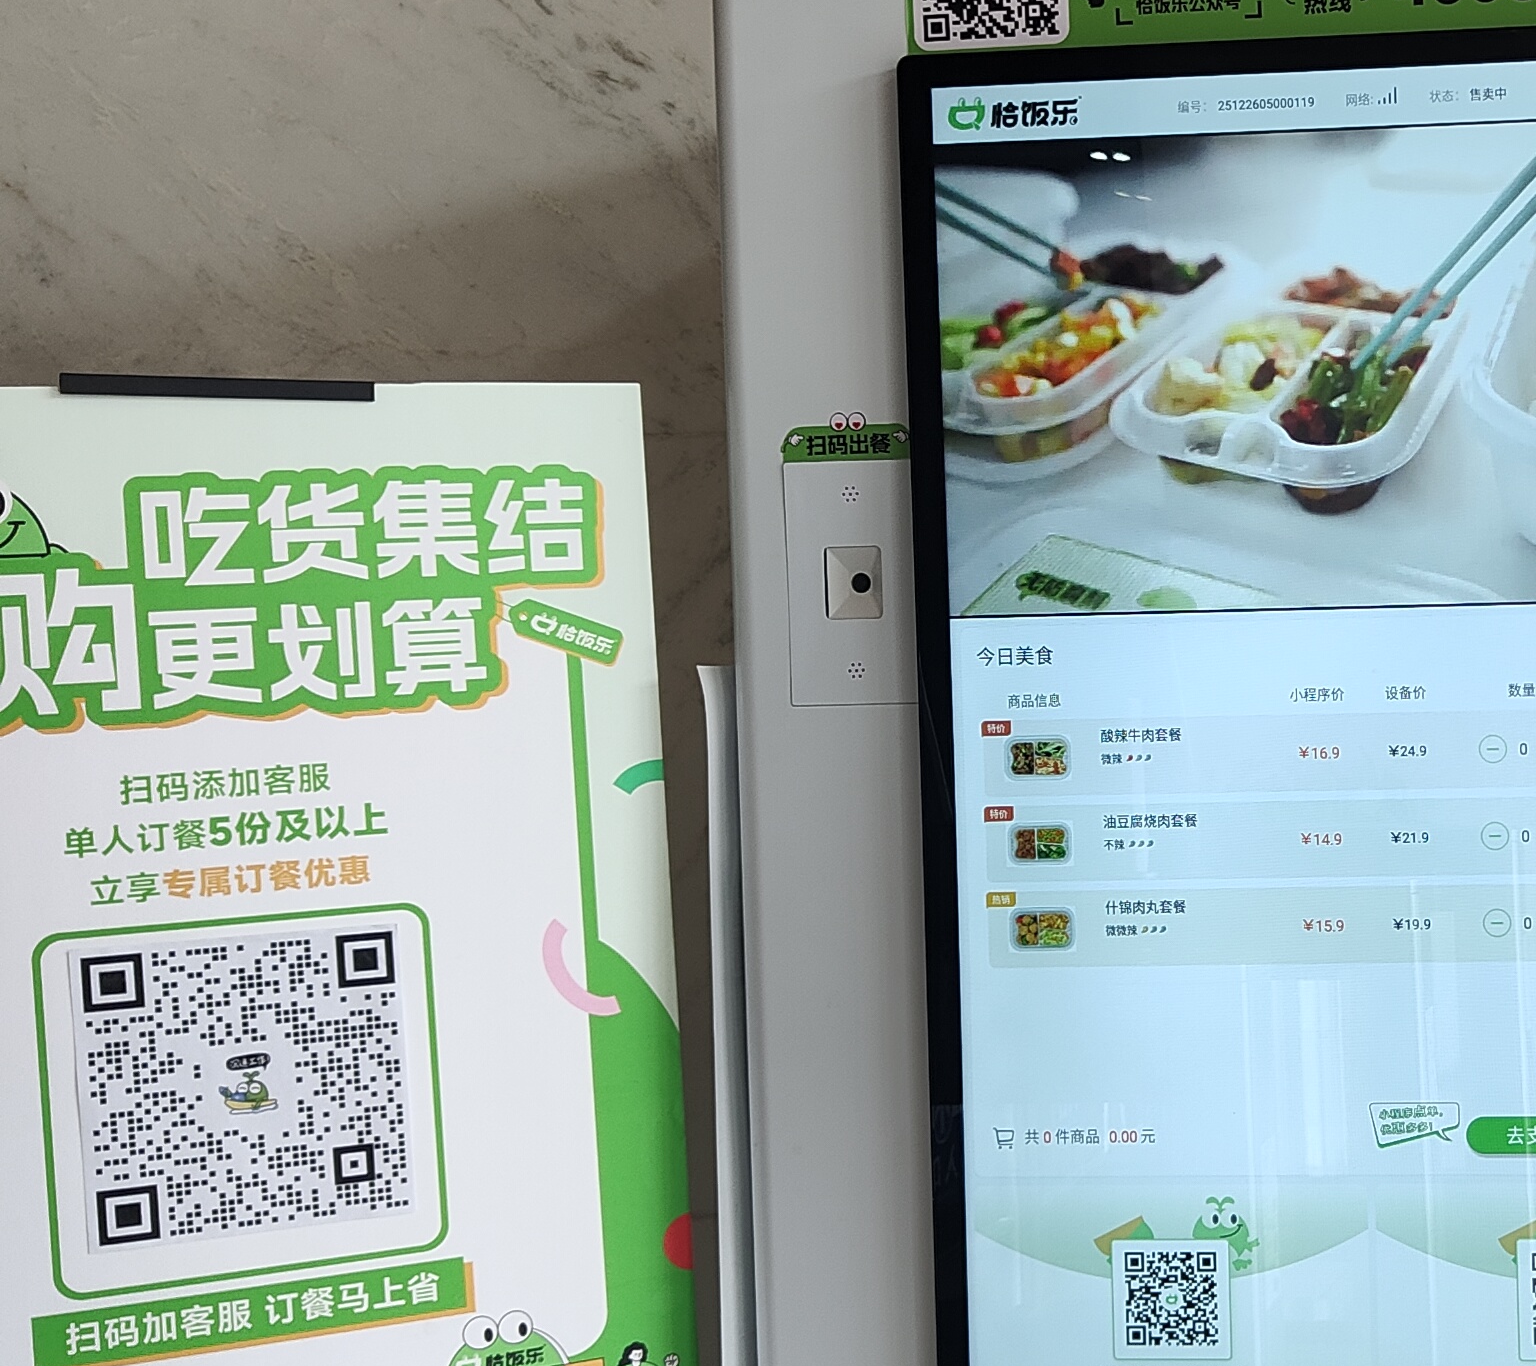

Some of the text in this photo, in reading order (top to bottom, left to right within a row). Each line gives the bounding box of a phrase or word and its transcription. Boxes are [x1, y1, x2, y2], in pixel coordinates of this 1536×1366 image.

[1218, 97, 1315, 111] 25122605000119
[1469, 87, 1507, 102] 售卖中
[991, 98, 1079, 128] 恰饭乐
[806, 433, 891, 456] 扫码出餐
[139, 477, 585, 586] 吃货集结
[556, 623, 618, 655] 恰饭乐
[976, 645, 1054, 668] 今日美食
[1007, 682, 1536, 709] 商品信息 小程序价 设备价 数量
[987, 723, 1006, 735] 特价
[1100, 727, 1528, 760] 酸辣牛肉套餐 ¥16.9 ¥24.9 0
[1101, 753, 1123, 766] 微辣
[120, 762, 331, 805] 扫码添加客服
[989, 808, 1008, 820] 特价
[64, 802, 388, 858] 单人订餐5份及以上
[1102, 813, 1530, 846] 油豆腐烧肉套餐 ¥14.9 ¥21.9 0
[1103, 839, 1125, 851] 不辣
[90, 855, 371, 906] 立享专属订餐优惠
[1105, 899, 1533, 933] 什锦肉丸套餐 ¥15.9 ¥19.9 0
[1105, 925, 1138, 937] 微微辣
[65, 1270, 441, 1356] 扫码加客服 订餐马上省
